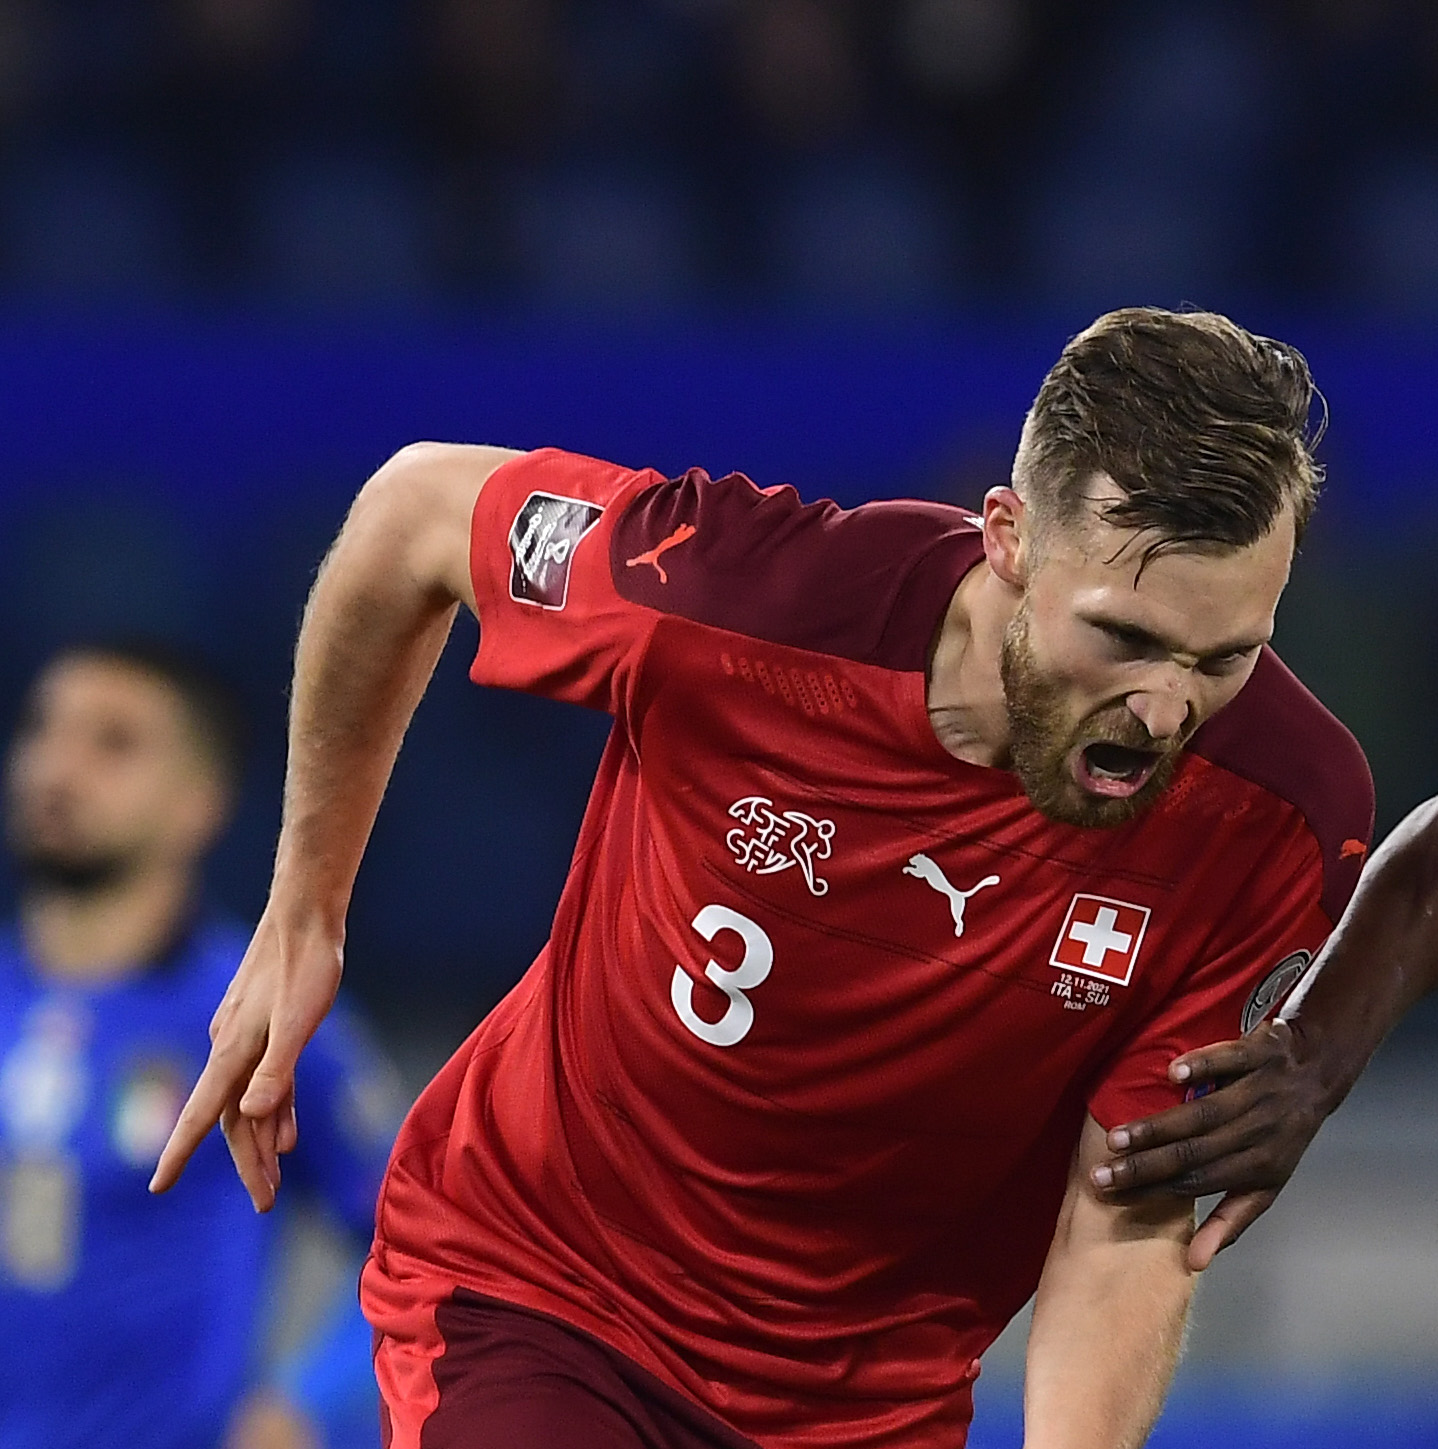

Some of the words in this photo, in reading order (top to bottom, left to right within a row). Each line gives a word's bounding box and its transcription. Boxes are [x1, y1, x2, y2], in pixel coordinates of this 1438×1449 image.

[671, 904, 774, 1047] 3
[1060, 972, 1110, 994] 12.11.2021
[1050, 981, 1073, 1000] ITA
[1084, 991, 1110, 1007] SUI
[1063, 1000, 1087, 1012] ROM
